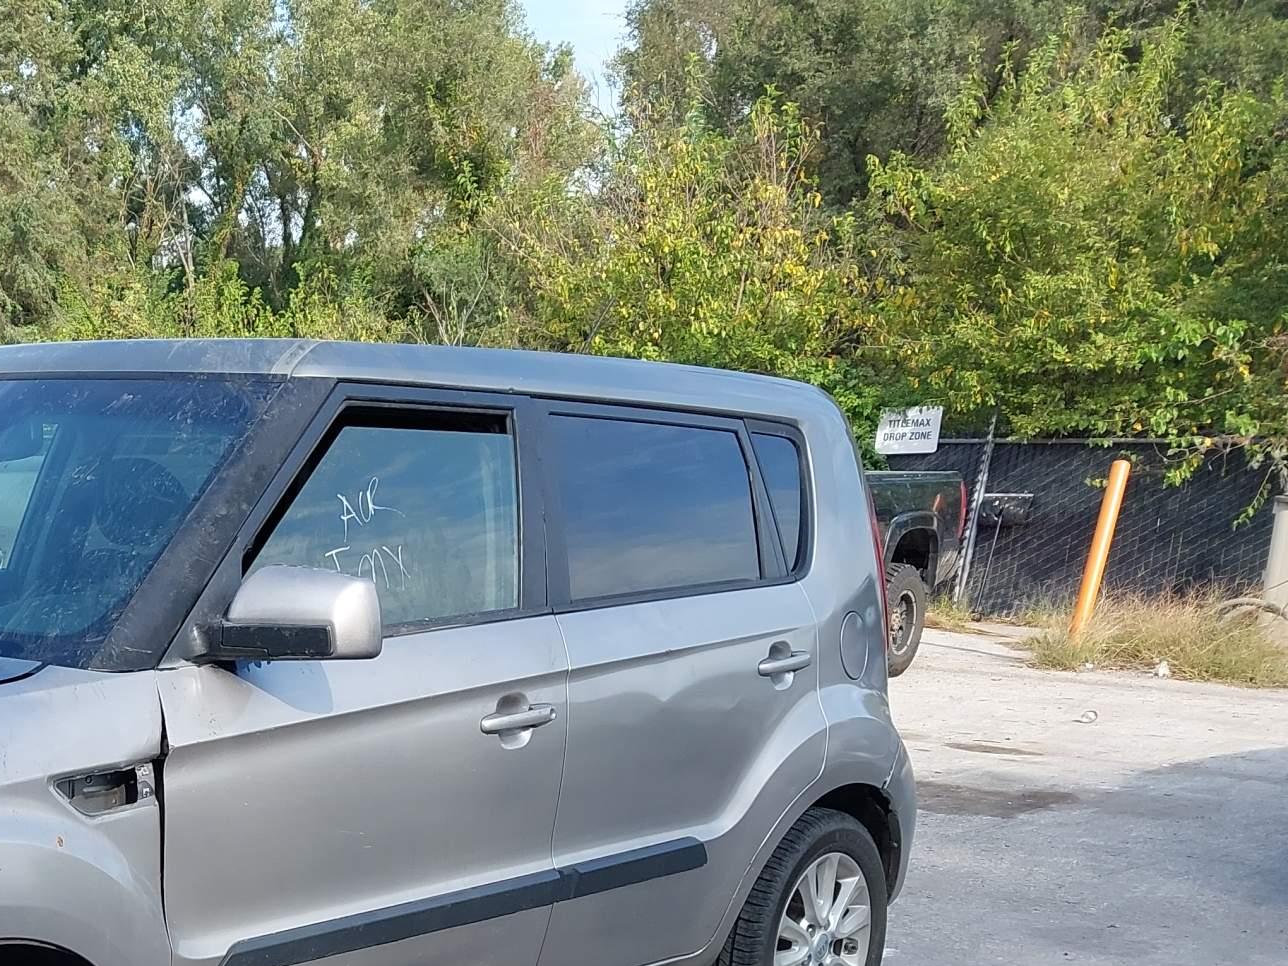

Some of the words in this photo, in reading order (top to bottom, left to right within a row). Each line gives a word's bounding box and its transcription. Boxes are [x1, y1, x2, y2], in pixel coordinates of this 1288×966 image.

[888, 418, 932, 428] TITLEMAX
[883, 432, 907, 441] DROP
[909, 431, 932, 440] ZONE
